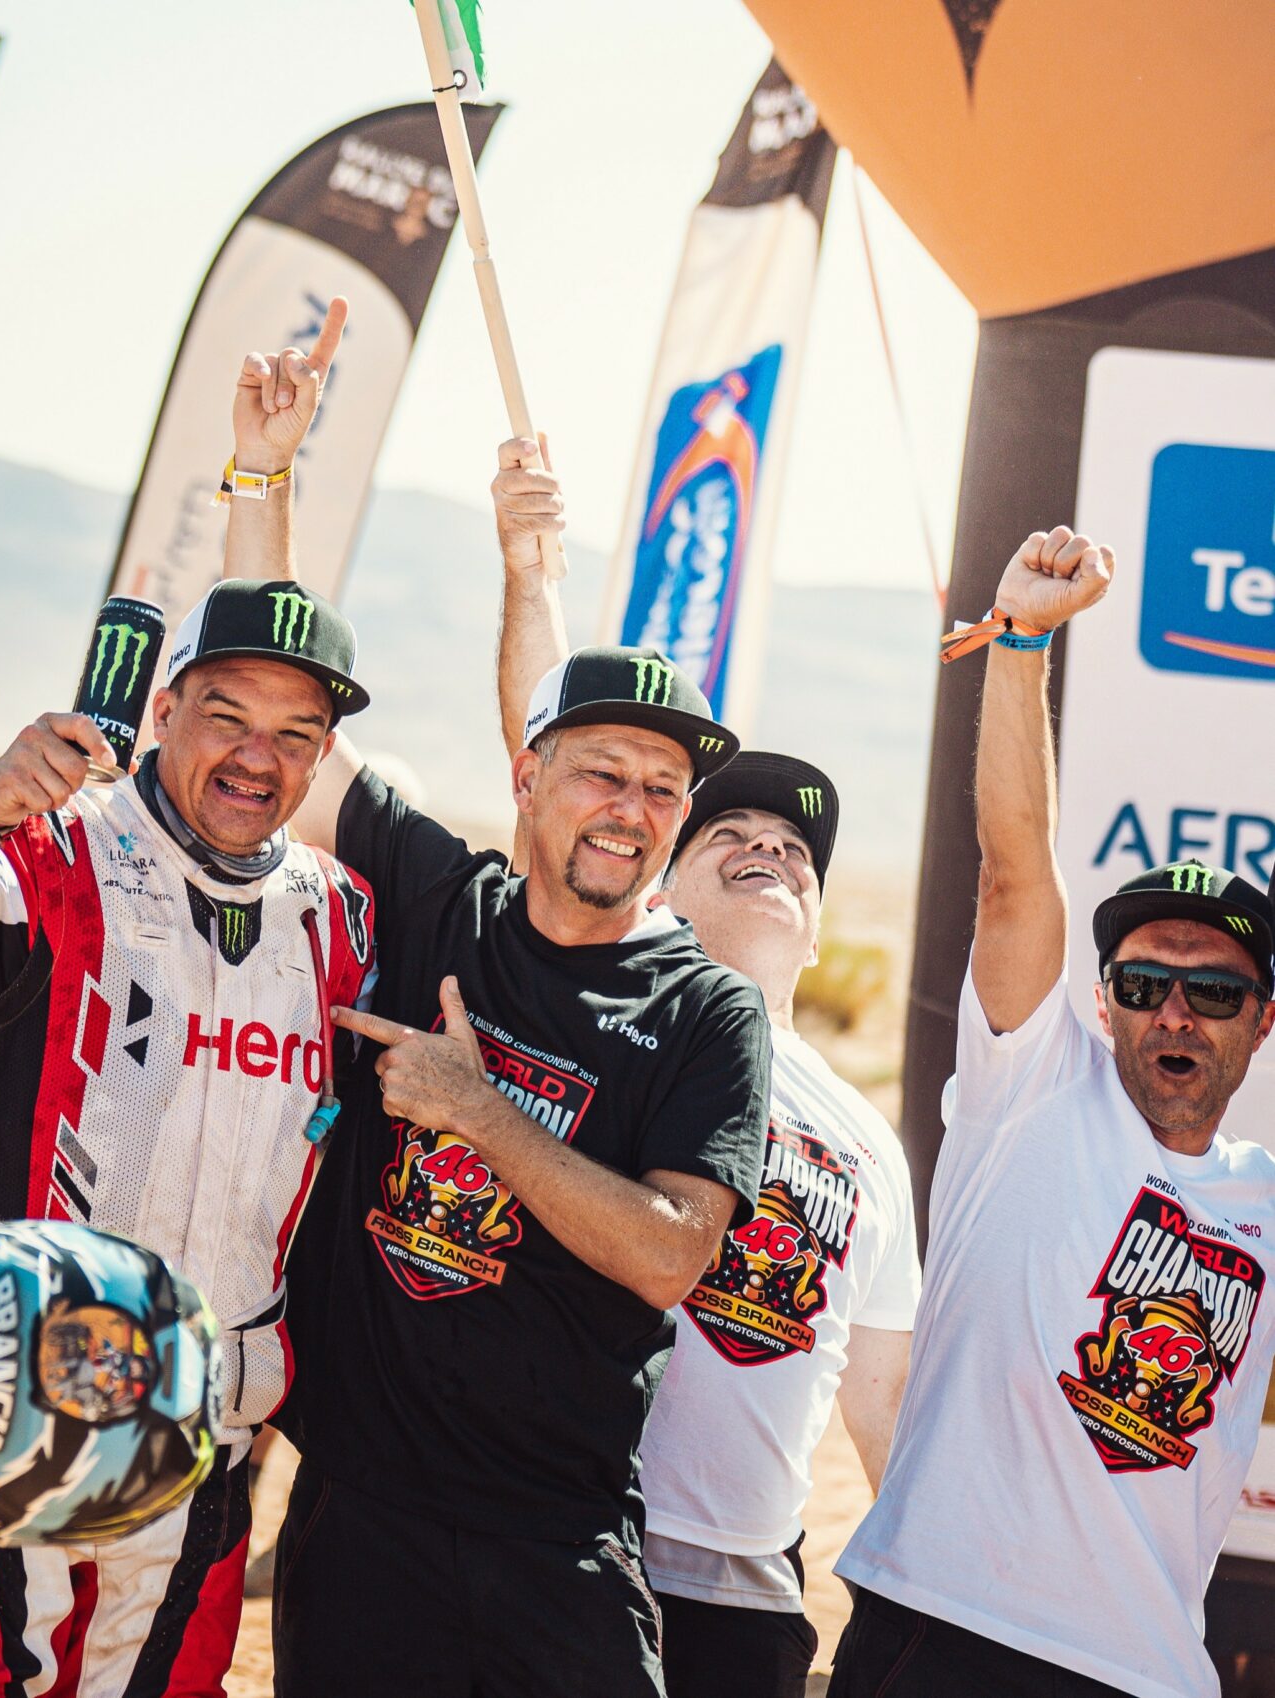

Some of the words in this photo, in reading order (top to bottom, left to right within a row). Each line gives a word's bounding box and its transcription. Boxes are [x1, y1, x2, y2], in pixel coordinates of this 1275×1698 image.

[81, 711, 136, 743] NSTER
[182, 1012, 325, 1094] Hero
[474, 1016, 514, 1044] RALLY-RAID
[513, 1040, 579, 1073] CHAMPIONSHIP
[578, 1067, 600, 1087] 2024
[619, 1020, 659, 1050] Hero
[419, 1143, 492, 1195] 46
[766, 1121, 845, 1175] ORLD
[837, 1150, 860, 1168] 2024
[1145, 1173, 1178, 1197] WORLD
[370, 1215, 413, 1245] ROSS
[415, 1236, 499, 1279] BRANCH
[732, 1216, 805, 1263] 46
[1159, 1204, 1254, 1281] WRLD
[385, 1244, 409, 1261] HERO
[409, 1253, 470, 1286] MOTOSPORTS
[687, 1289, 734, 1313] OSS
[735, 1306, 813, 1346] BRANCH
[696, 1310, 724, 1327] HERO
[724, 1320, 787, 1353] MOTOSPORTS
[1126, 1323, 1205, 1373] 46
[1062, 1381, 1114, 1418] ROSS
[1114, 1411, 1190, 1461] BRANCH
[1100, 1426, 1159, 1465] MOTOSPORTS
